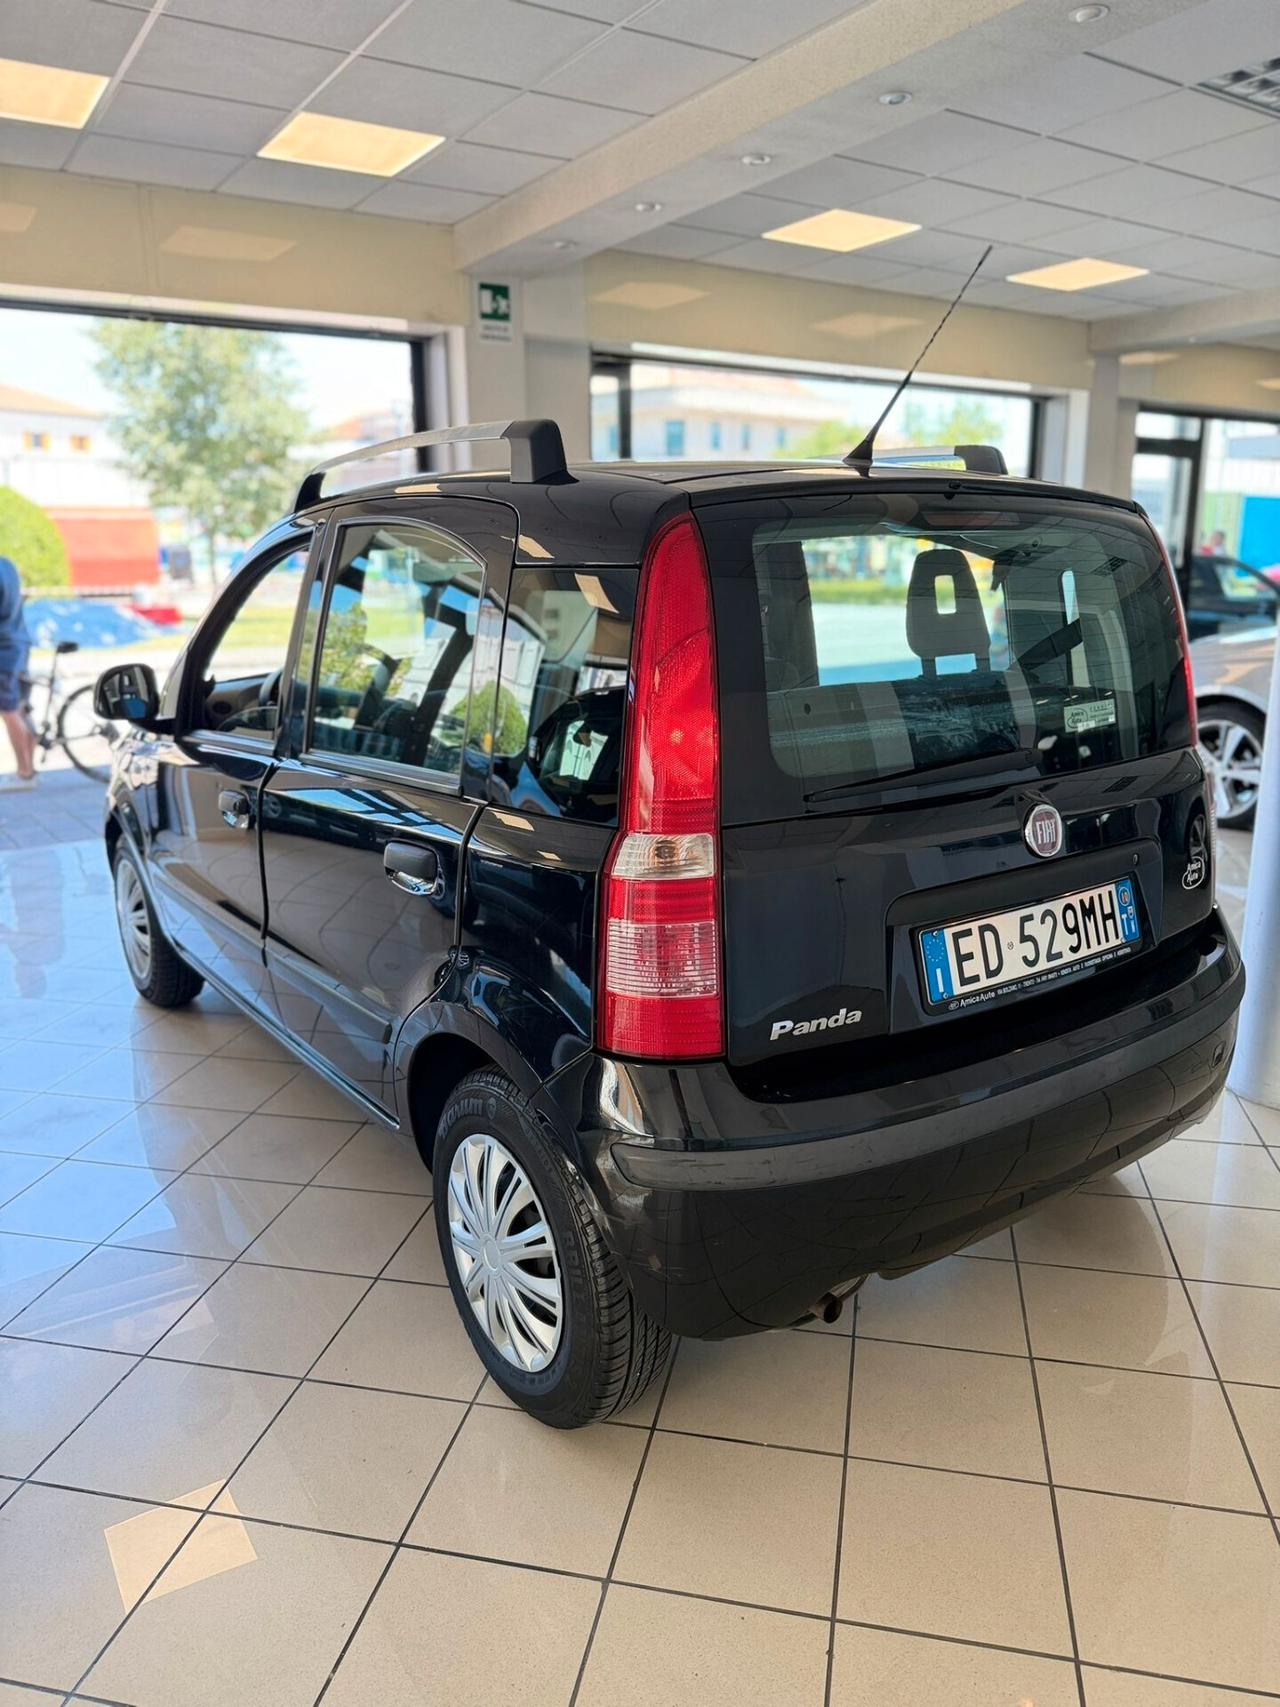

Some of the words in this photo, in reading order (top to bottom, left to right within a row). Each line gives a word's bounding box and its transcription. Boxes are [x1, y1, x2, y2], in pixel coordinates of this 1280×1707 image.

[1035, 819, 1056, 845] FIAT
[935, 967, 945, 993] I
[952, 923, 1004, 987] ED
[1019, 890, 1120, 969] 529MH
[769, 1007, 862, 1040] Panda
